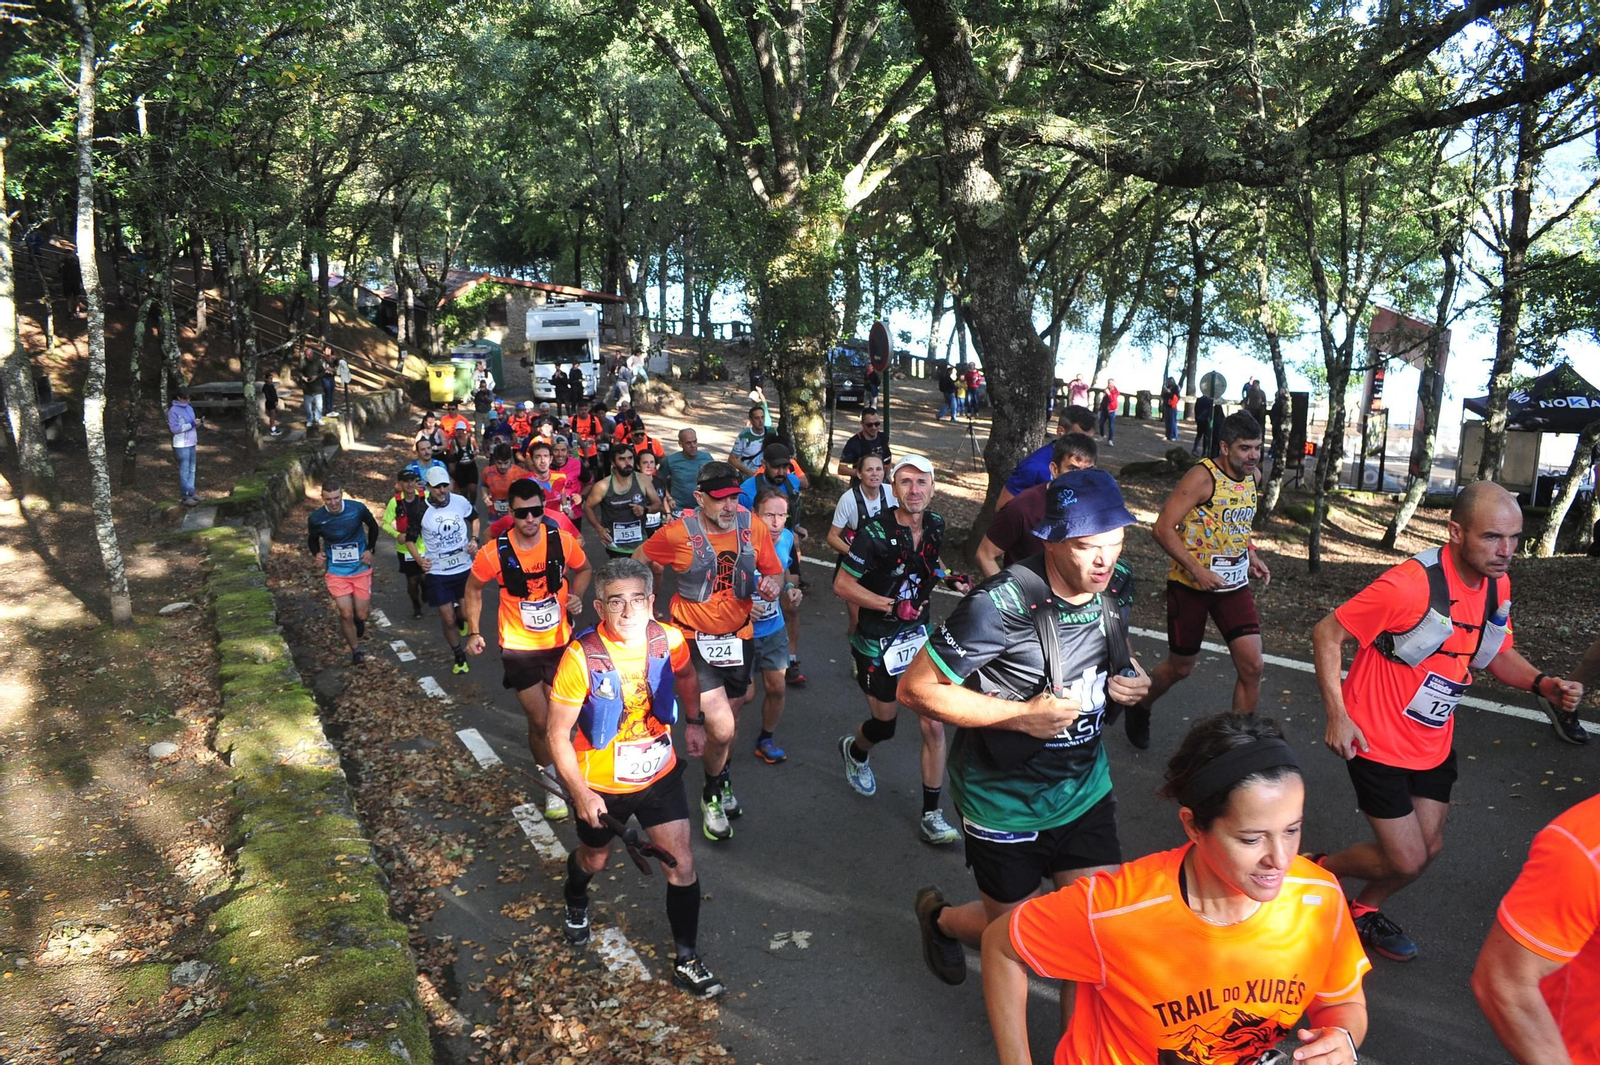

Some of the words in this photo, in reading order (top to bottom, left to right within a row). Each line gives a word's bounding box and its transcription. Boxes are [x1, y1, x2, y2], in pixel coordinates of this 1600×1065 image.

[621, 531, 635, 539] 153
[447, 558, 460, 566] 101
[531, 612, 552, 625] 150
[706, 645, 732, 658] 224
[630, 756, 661, 775] 207
[1153, 987, 1219, 1028] TRAIL
[1223, 985, 1240, 1004] DO
[1244, 973, 1307, 1006] XURÉS
